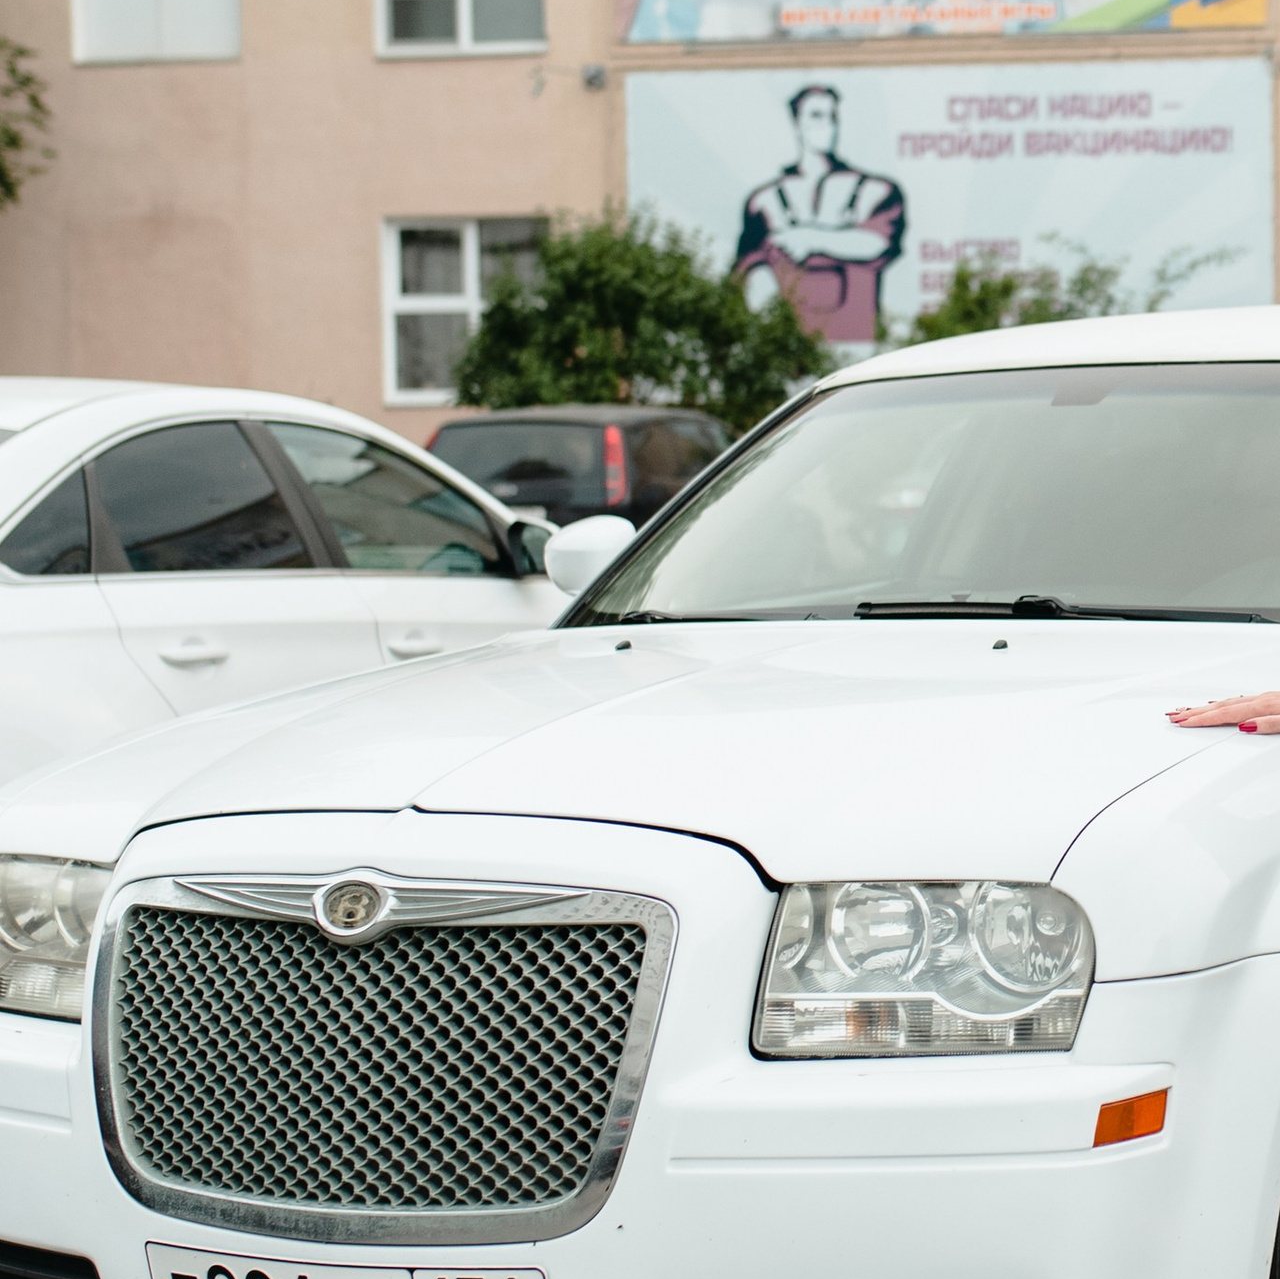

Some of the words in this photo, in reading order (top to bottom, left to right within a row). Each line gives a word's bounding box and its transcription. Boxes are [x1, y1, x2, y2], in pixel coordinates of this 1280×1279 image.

[947, 94, 1039, 122] СПАСИ
[1048, 91, 1152, 120] НАЦИЮ
[899, 128, 1014, 160] ПРОЙДИ
[1023, 124, 1235, 159] ВАКЦИНАЦИЮ!
